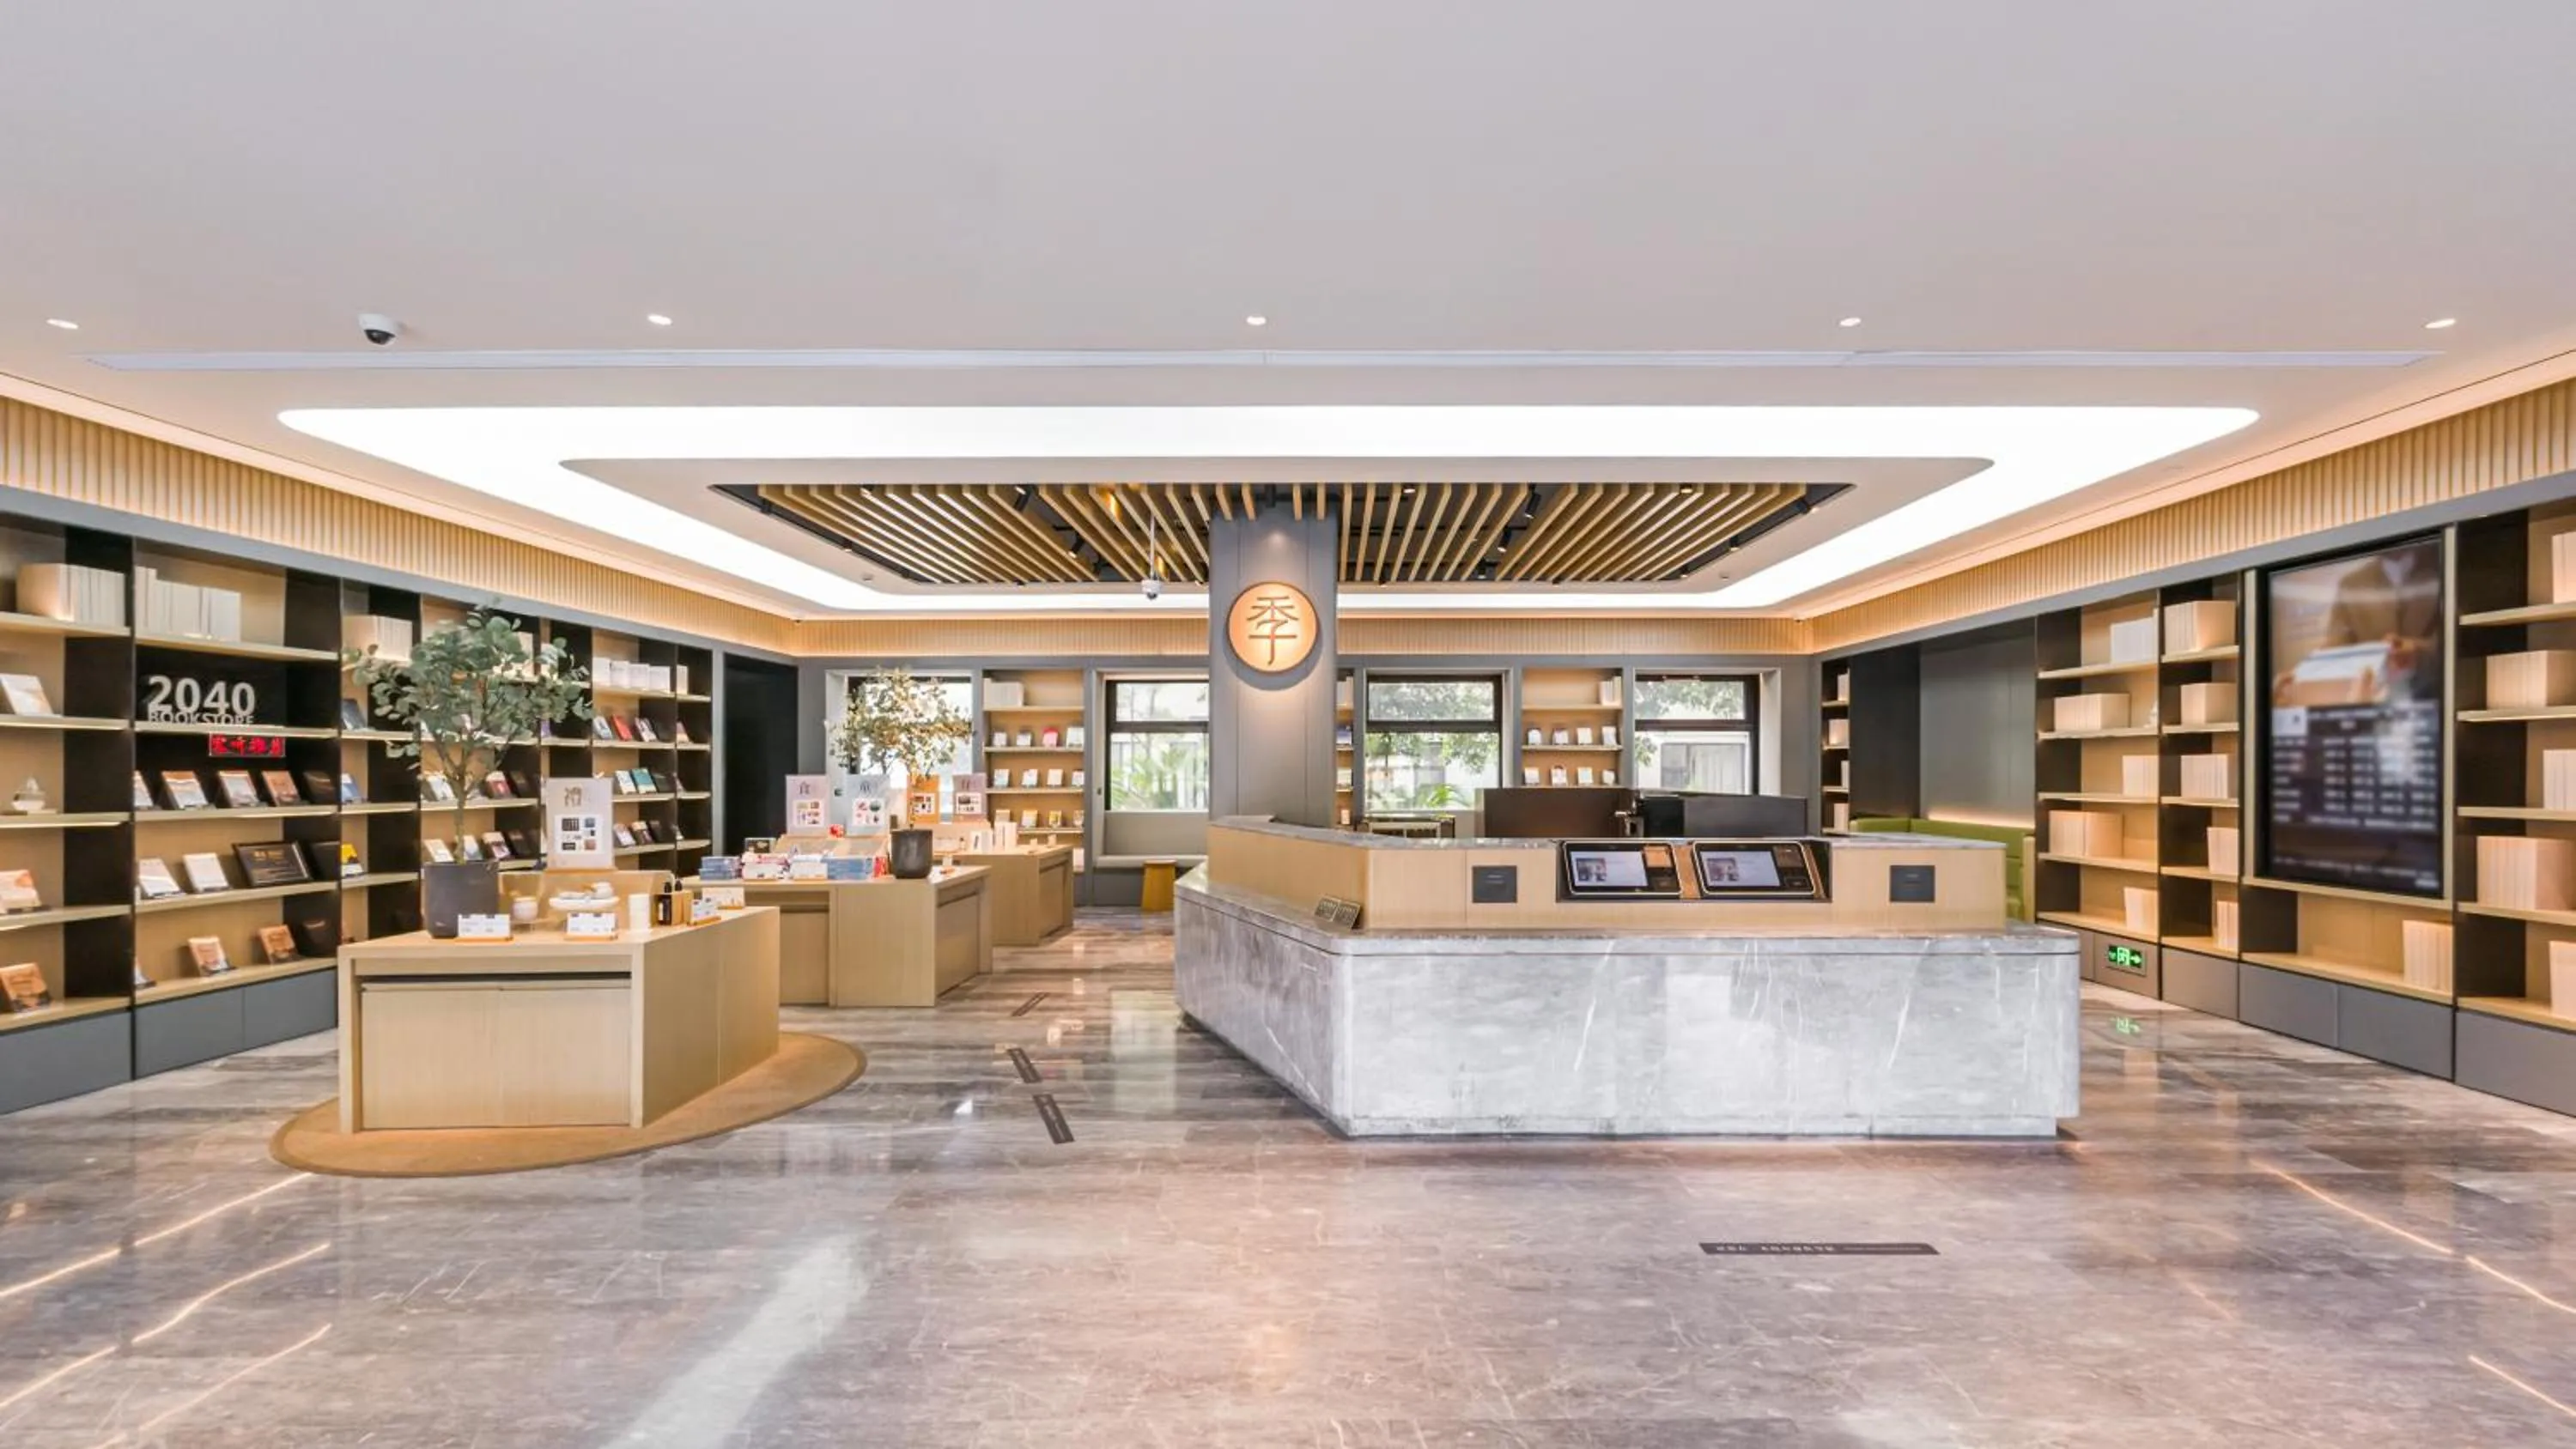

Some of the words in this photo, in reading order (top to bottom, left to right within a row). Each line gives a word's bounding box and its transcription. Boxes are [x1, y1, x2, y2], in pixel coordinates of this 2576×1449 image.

[1246, 595, 1300, 666] 季
[149, 675, 255, 716] 2040
[149, 710, 255, 724] BOOKSTORE
